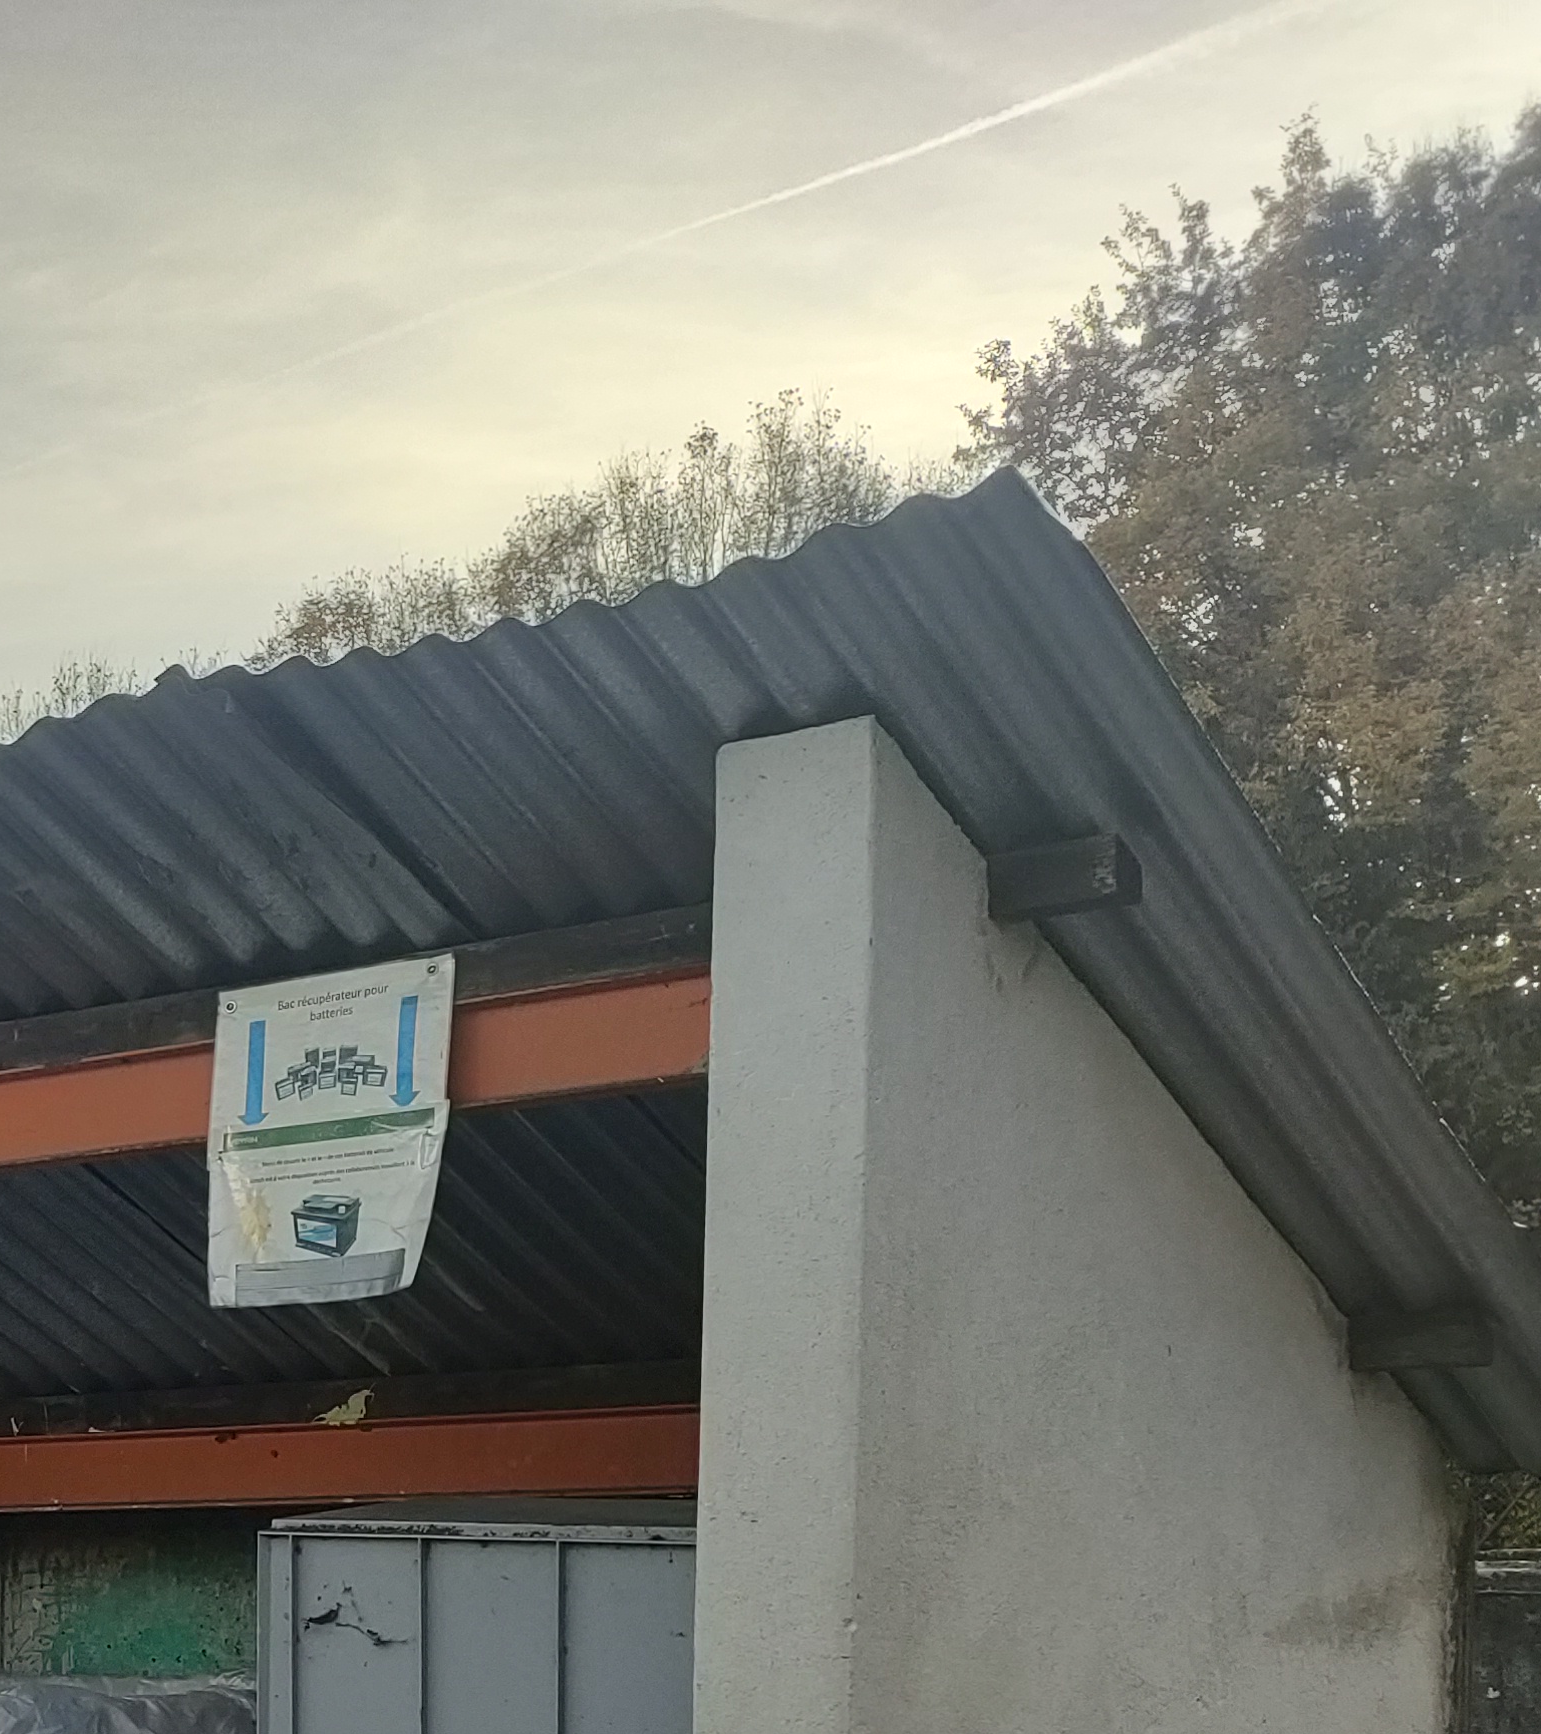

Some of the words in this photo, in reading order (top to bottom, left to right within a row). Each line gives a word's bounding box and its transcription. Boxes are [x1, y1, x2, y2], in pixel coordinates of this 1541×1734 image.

[277, 999, 295, 1011] Bac
[298, 989, 362, 1007] récupérateur
[364, 984, 389, 998] pour
[310, 1006, 354, 1021] batteries
